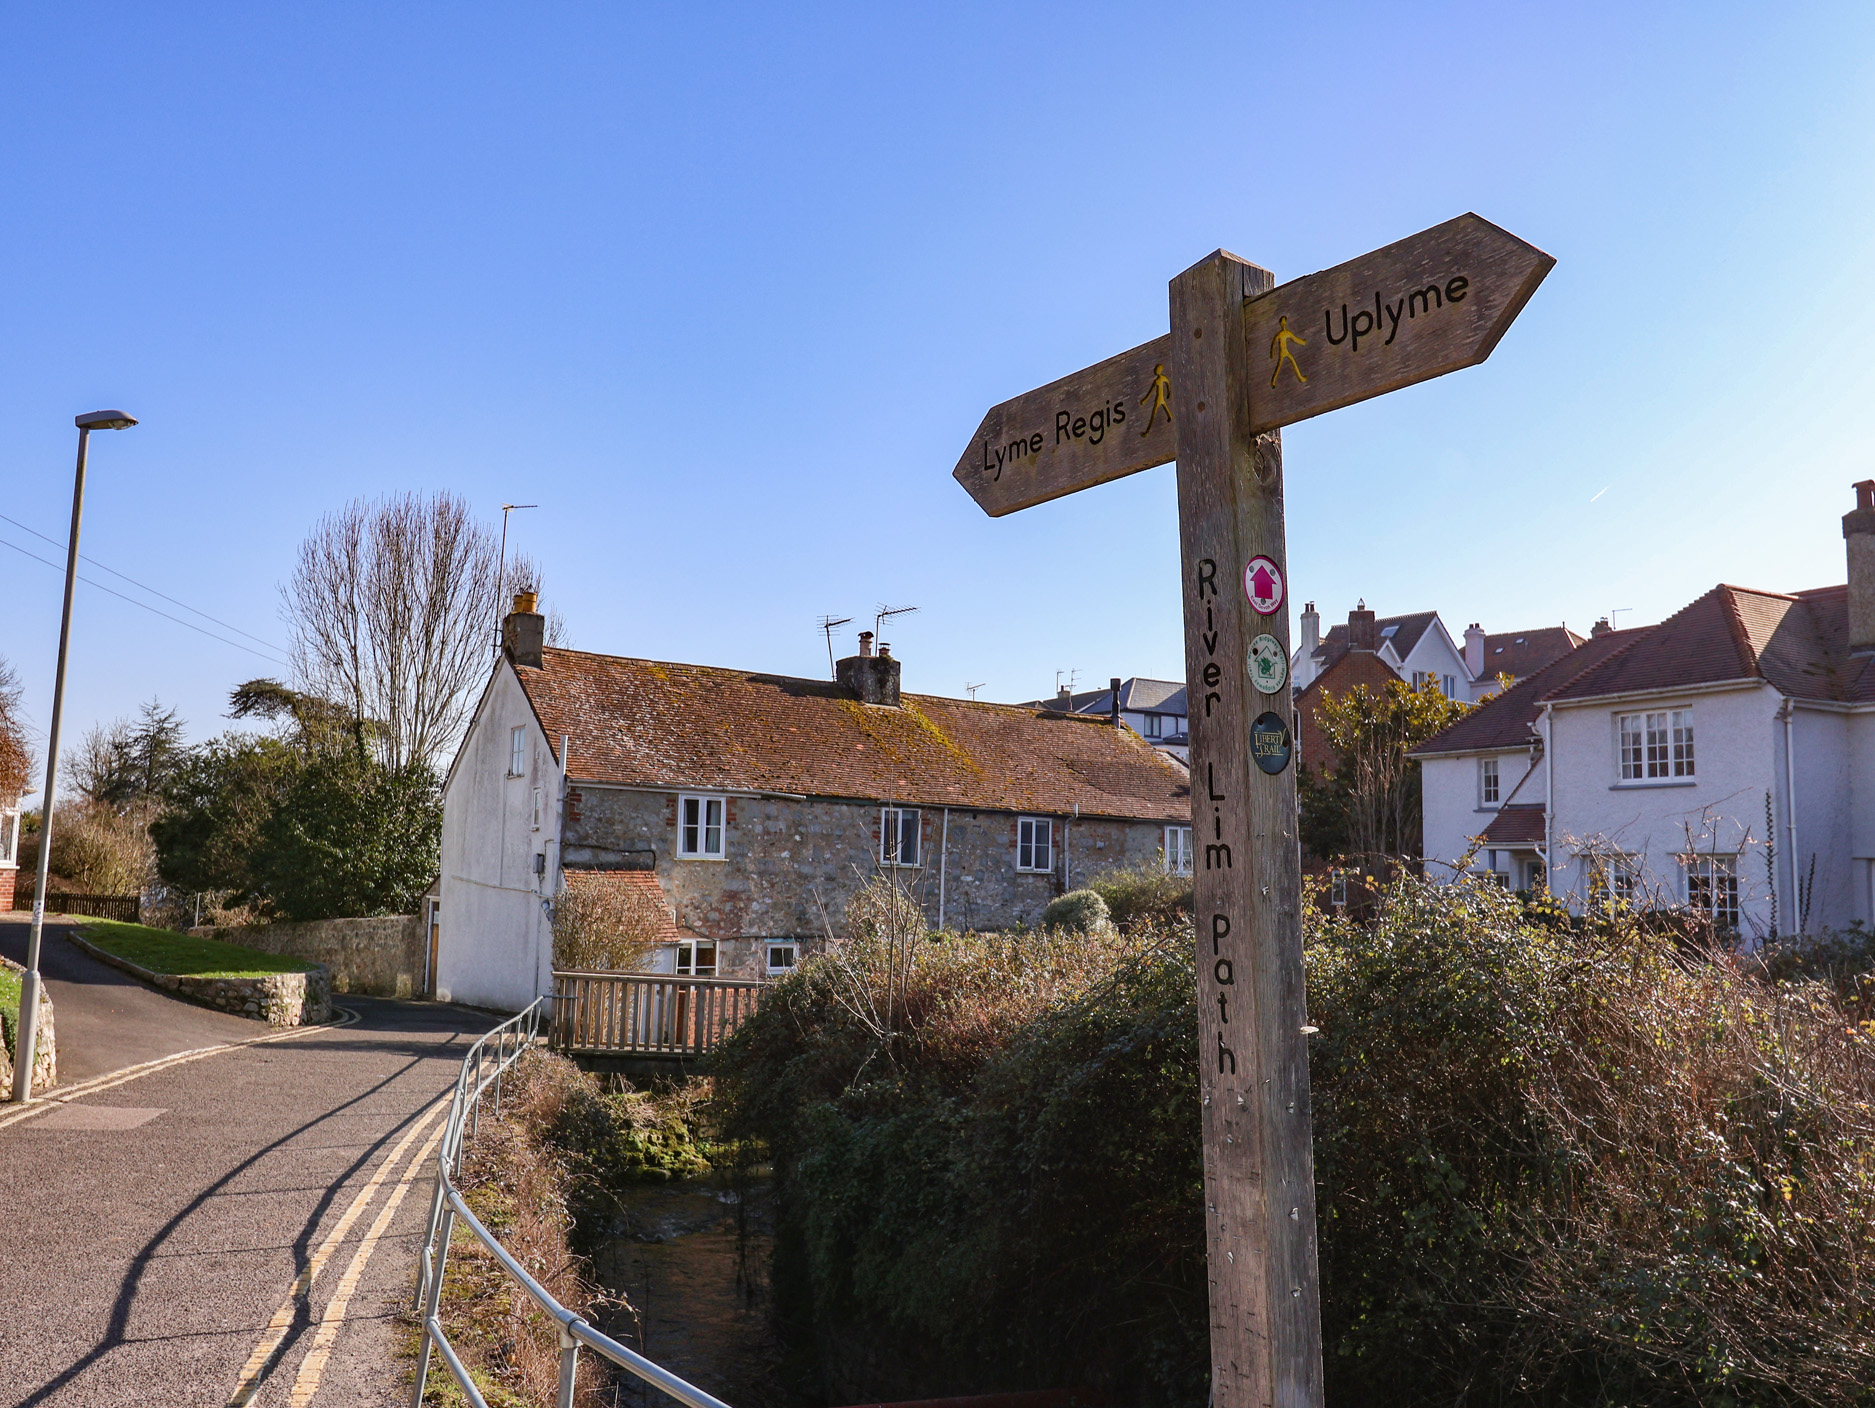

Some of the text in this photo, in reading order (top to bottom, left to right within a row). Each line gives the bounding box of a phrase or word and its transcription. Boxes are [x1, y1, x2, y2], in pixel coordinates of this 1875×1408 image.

[1325, 275, 1469, 352] Uplyme
[984, 400, 1126, 482] Lyme Regis
[1254, 728, 1287, 748] LIBERTY
[1199, 558, 1236, 1075] River Lim Path
